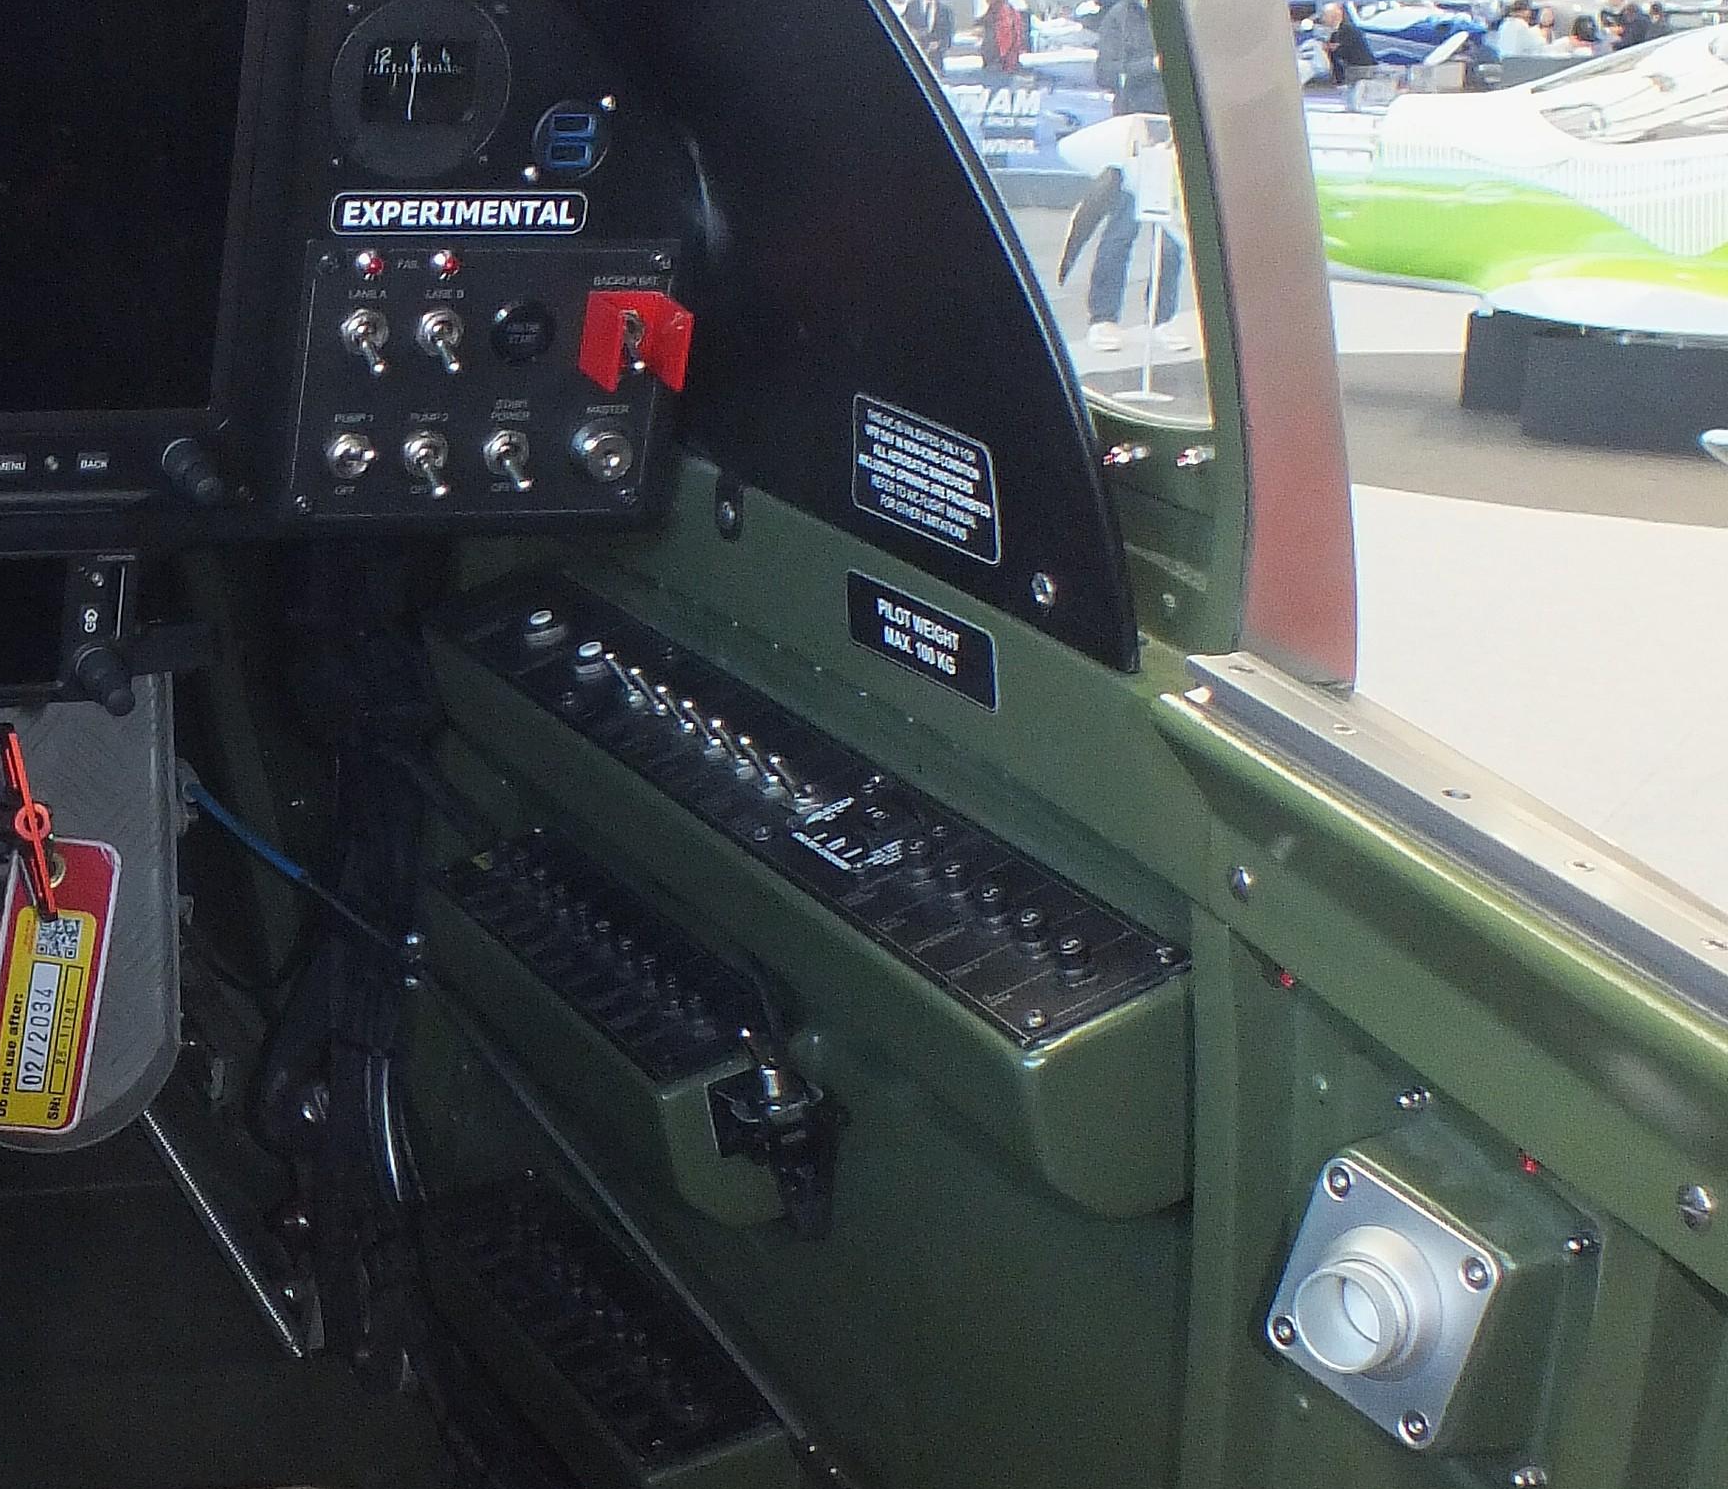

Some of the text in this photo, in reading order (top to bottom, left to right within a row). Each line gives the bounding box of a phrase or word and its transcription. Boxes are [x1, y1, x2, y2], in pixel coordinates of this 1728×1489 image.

[341, 199, 576, 227] EXPERIMENTAL
[80, 459, 108, 470] BACK
[877, 597, 960, 651] PILOT WEIGHT
[915, 640, 935, 667] 100
[935, 649, 957, 676] KG
[10, 993, 24, 1036] after:
[22, 988, 54, 1086] 02/2034
[6, 1041, 17, 1068] use
[2, 1071, 13, 1094] not
